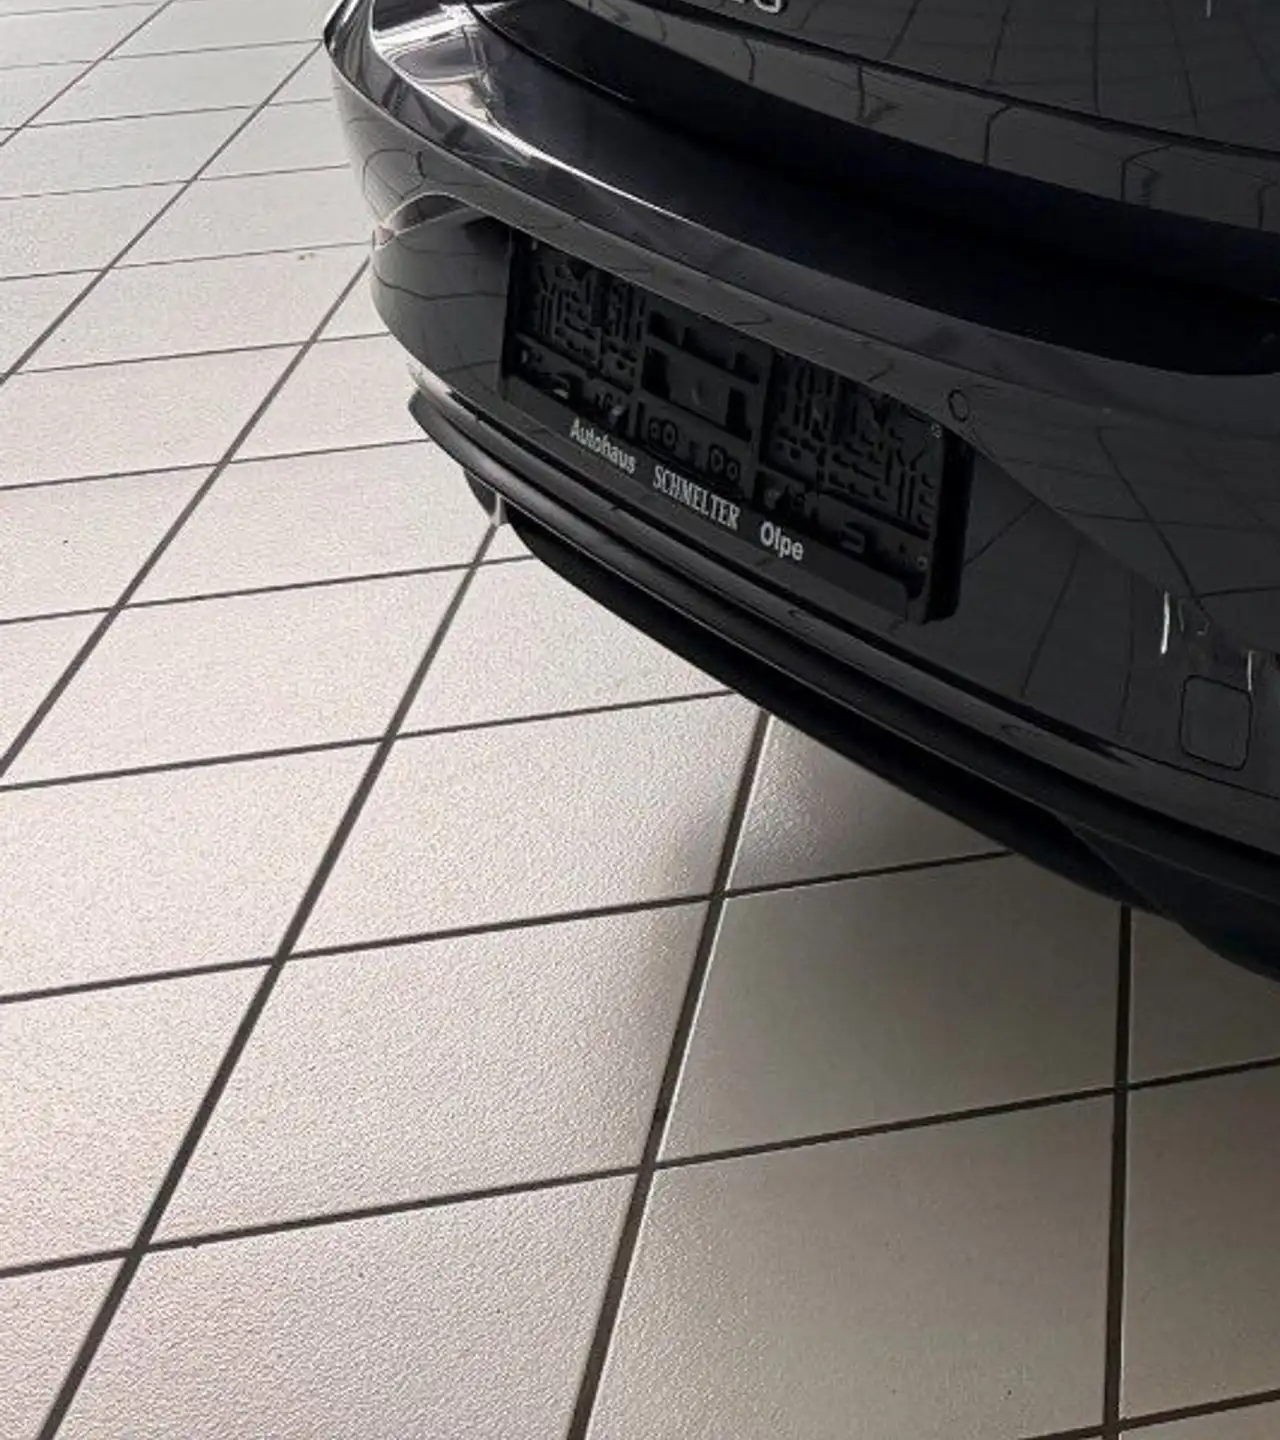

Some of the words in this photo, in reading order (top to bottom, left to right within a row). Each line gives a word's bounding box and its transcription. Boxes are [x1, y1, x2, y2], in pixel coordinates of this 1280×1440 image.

[569, 416, 636, 475] Autohaus
[652, 464, 741, 531] SCHMELTER
[758, 520, 804, 561] Olpe
